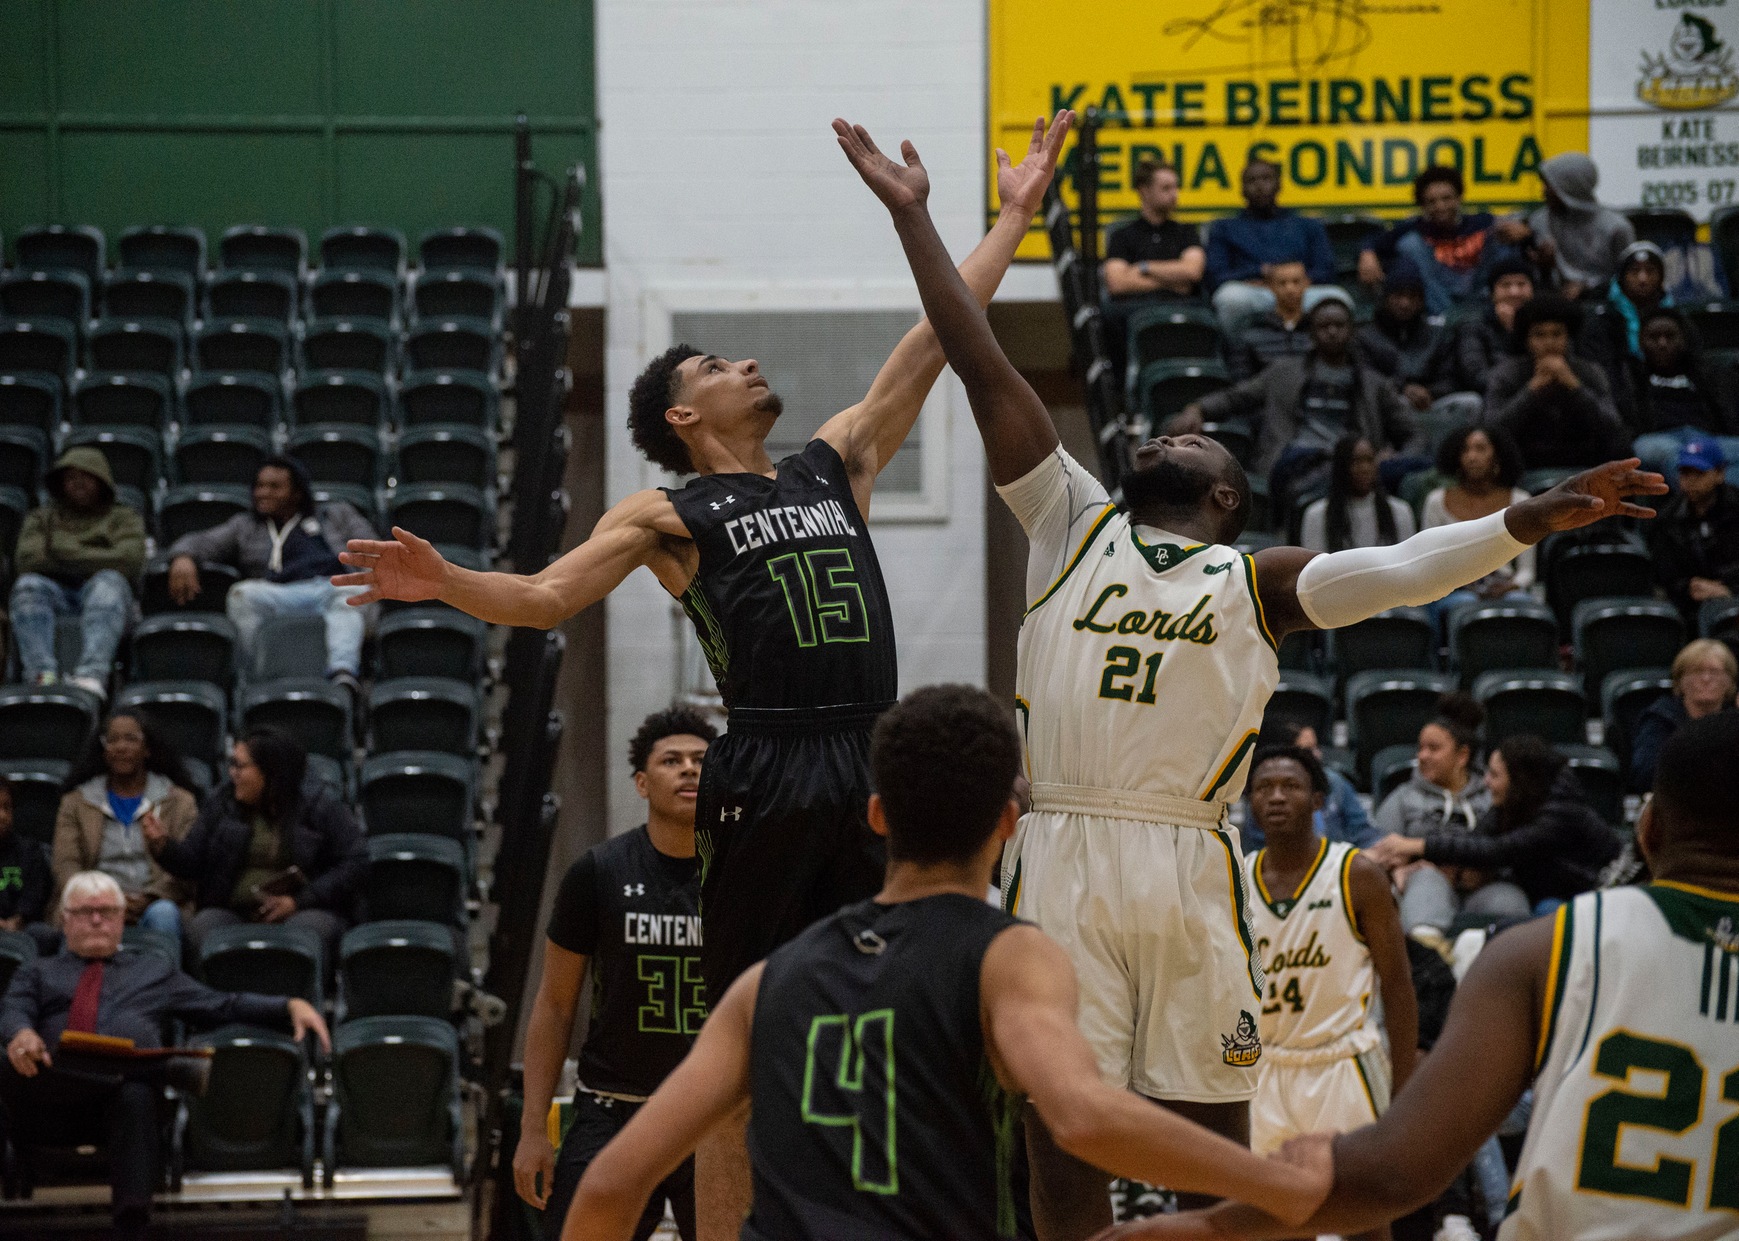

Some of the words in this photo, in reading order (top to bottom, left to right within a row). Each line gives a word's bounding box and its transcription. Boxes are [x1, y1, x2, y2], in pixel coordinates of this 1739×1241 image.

[1051, 80, 1206, 128] KATE
[1225, 74, 1534, 127] BEIRNESS
[1662, 118, 1715, 140] KATE
[1055, 141, 1232, 191] EDIA
[724, 499, 858, 556] CENTENNIAL
[766, 548, 870, 648] 15
[1073, 583, 1219, 646] Lords
[1098, 645, 1164, 706] 21
[624, 912, 703, 947] CENTEN
[801, 1007, 899, 1196] 4
[1573, 1026, 1739, 1213] 2
